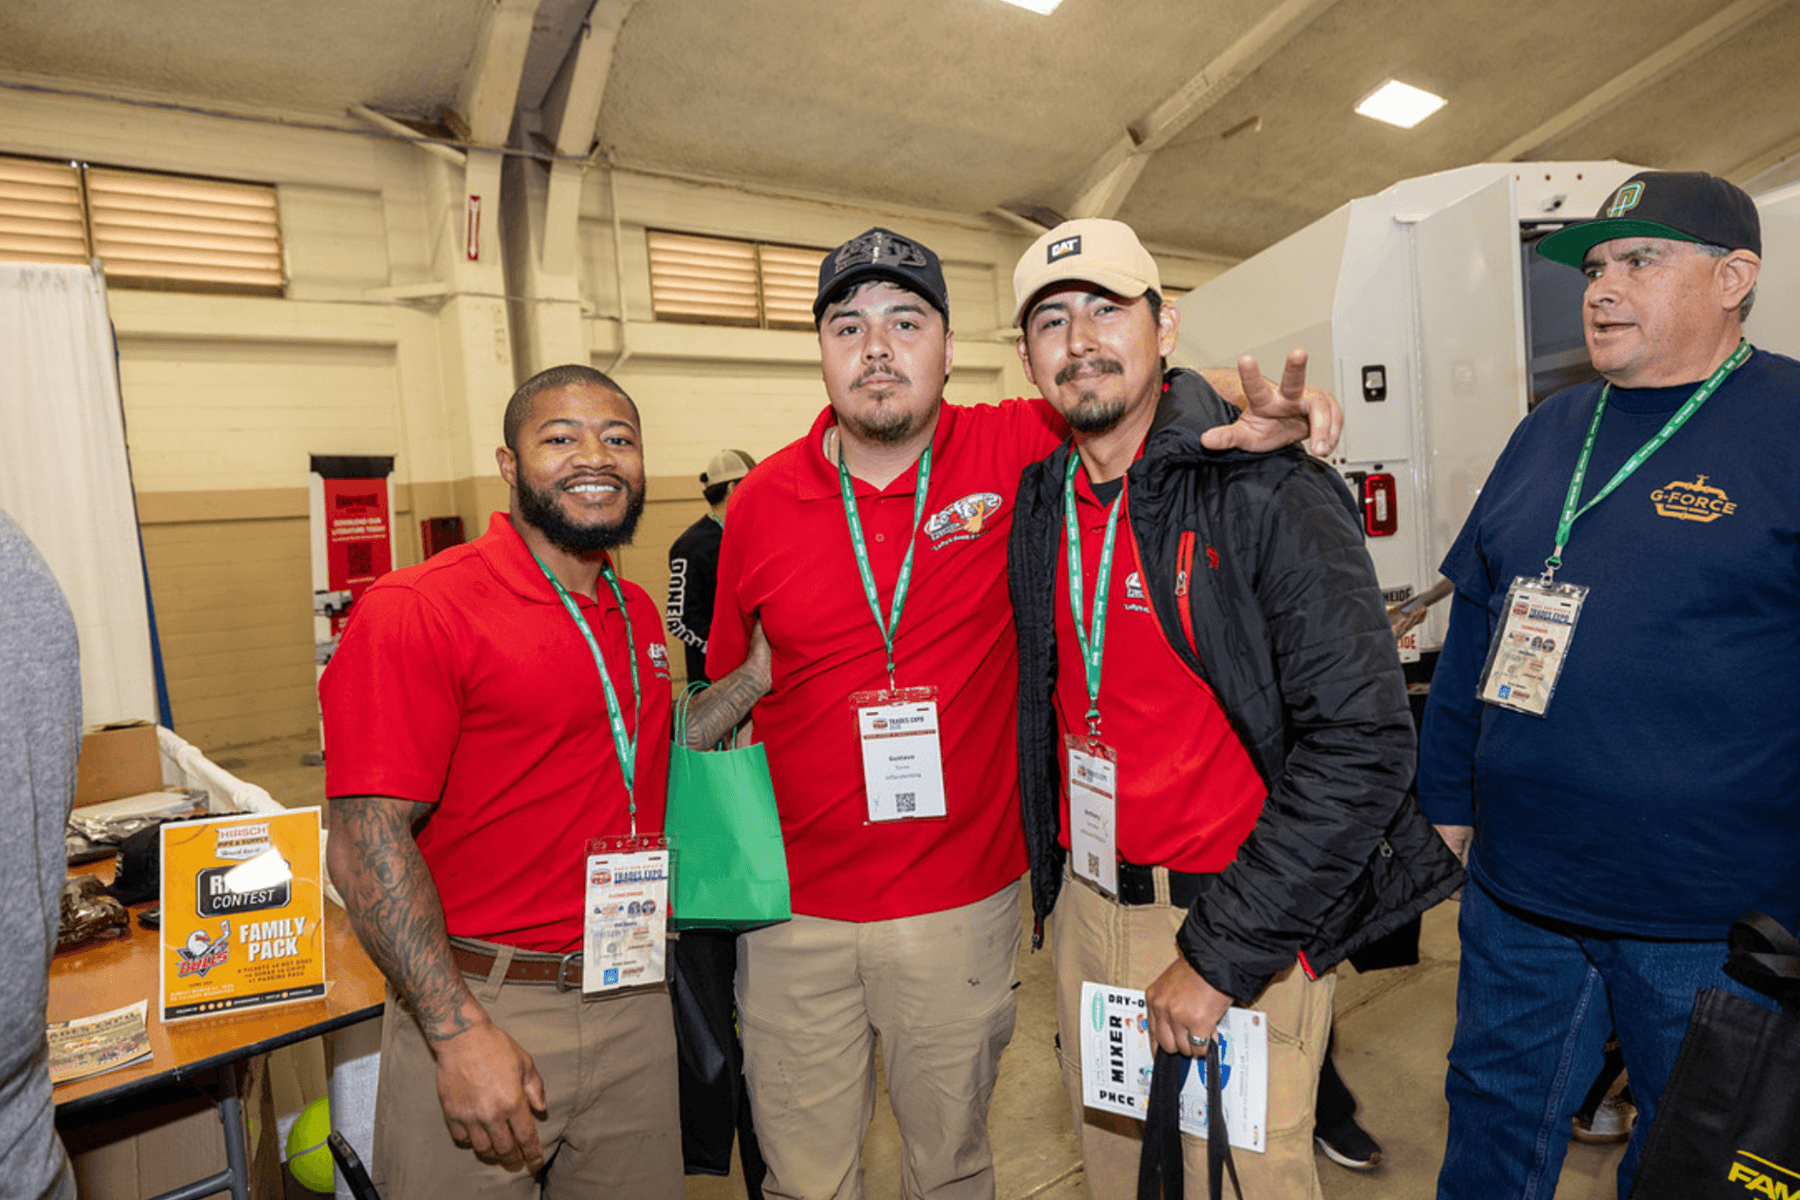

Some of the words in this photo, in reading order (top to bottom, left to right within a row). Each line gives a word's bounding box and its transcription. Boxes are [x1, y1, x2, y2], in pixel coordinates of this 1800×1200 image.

[1052, 239, 1078, 257] CAT
[1650, 489, 1737, 515] G-FORCE
[220, 827, 266, 839] HIRSCH
[213, 890, 275, 909] CONTEST
[239, 917, 306, 943] FAMILY
[248, 937, 298, 962] PACK
[179, 951, 228, 976] GULLS
[1110, 1015, 1124, 1083] MIXER
[1099, 1090, 1135, 1106] PHCC
